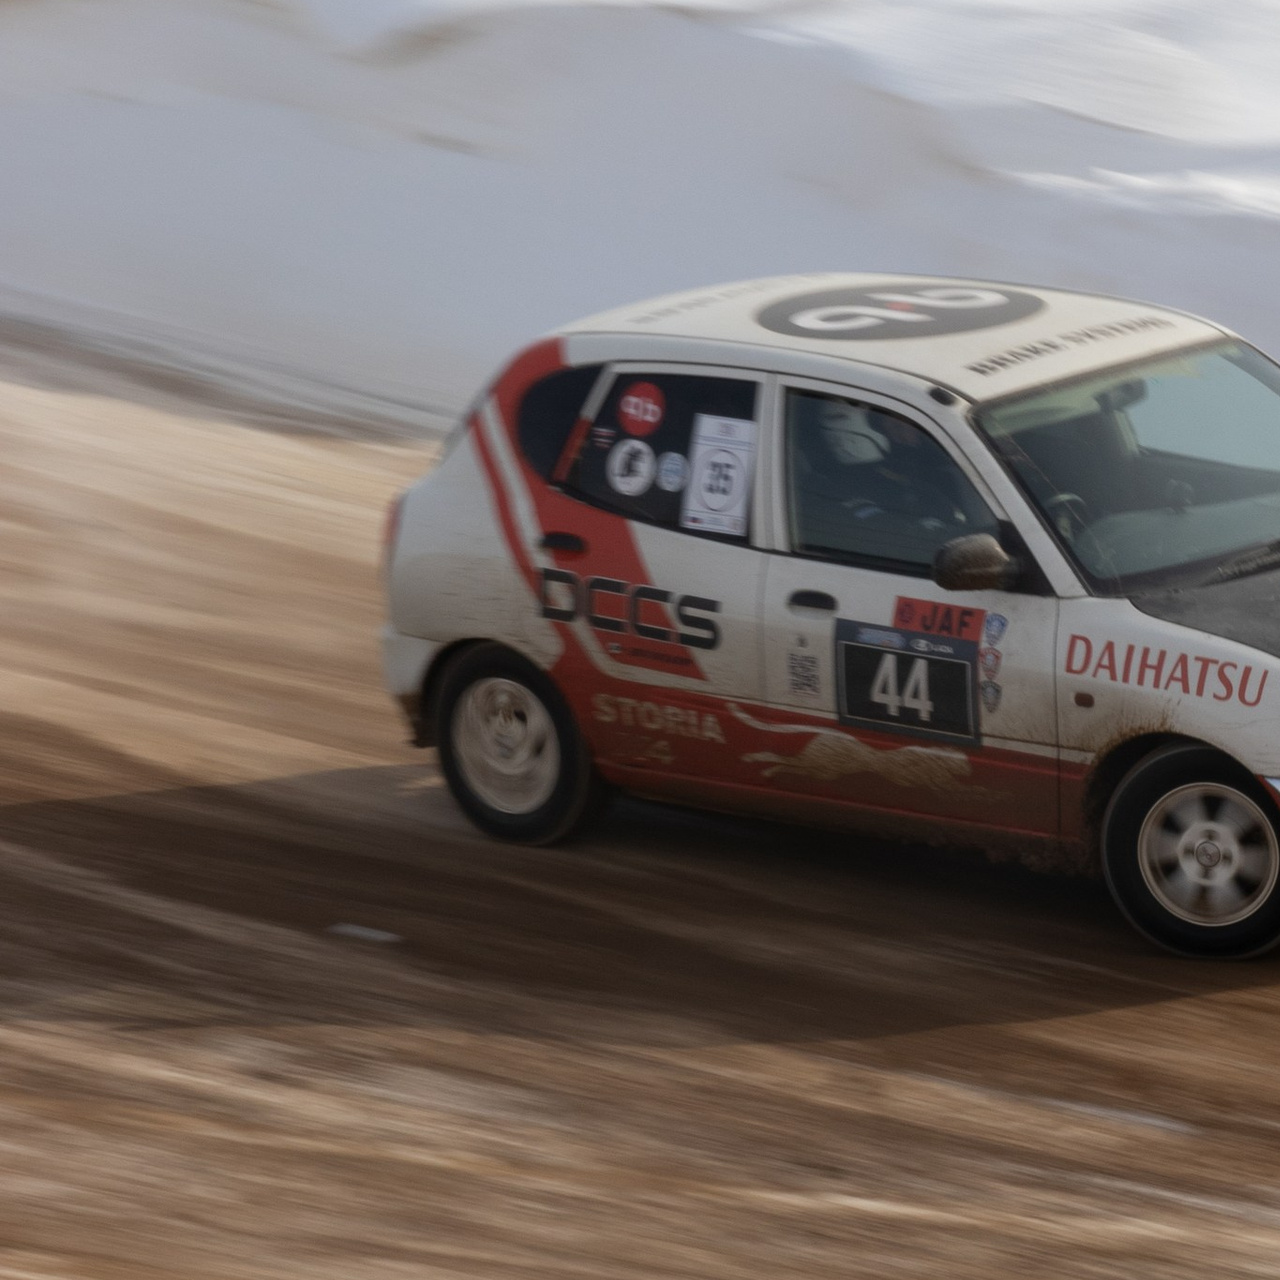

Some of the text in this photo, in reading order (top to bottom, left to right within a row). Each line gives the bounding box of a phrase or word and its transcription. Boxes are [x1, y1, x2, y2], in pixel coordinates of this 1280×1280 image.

[535, 567, 723, 651] DCCS
[920, 604, 974, 638] JAF
[870, 652, 935, 722] 44
[1065, 633, 1269, 708] DAIHATSU
[591, 692, 726, 744] STORIA
